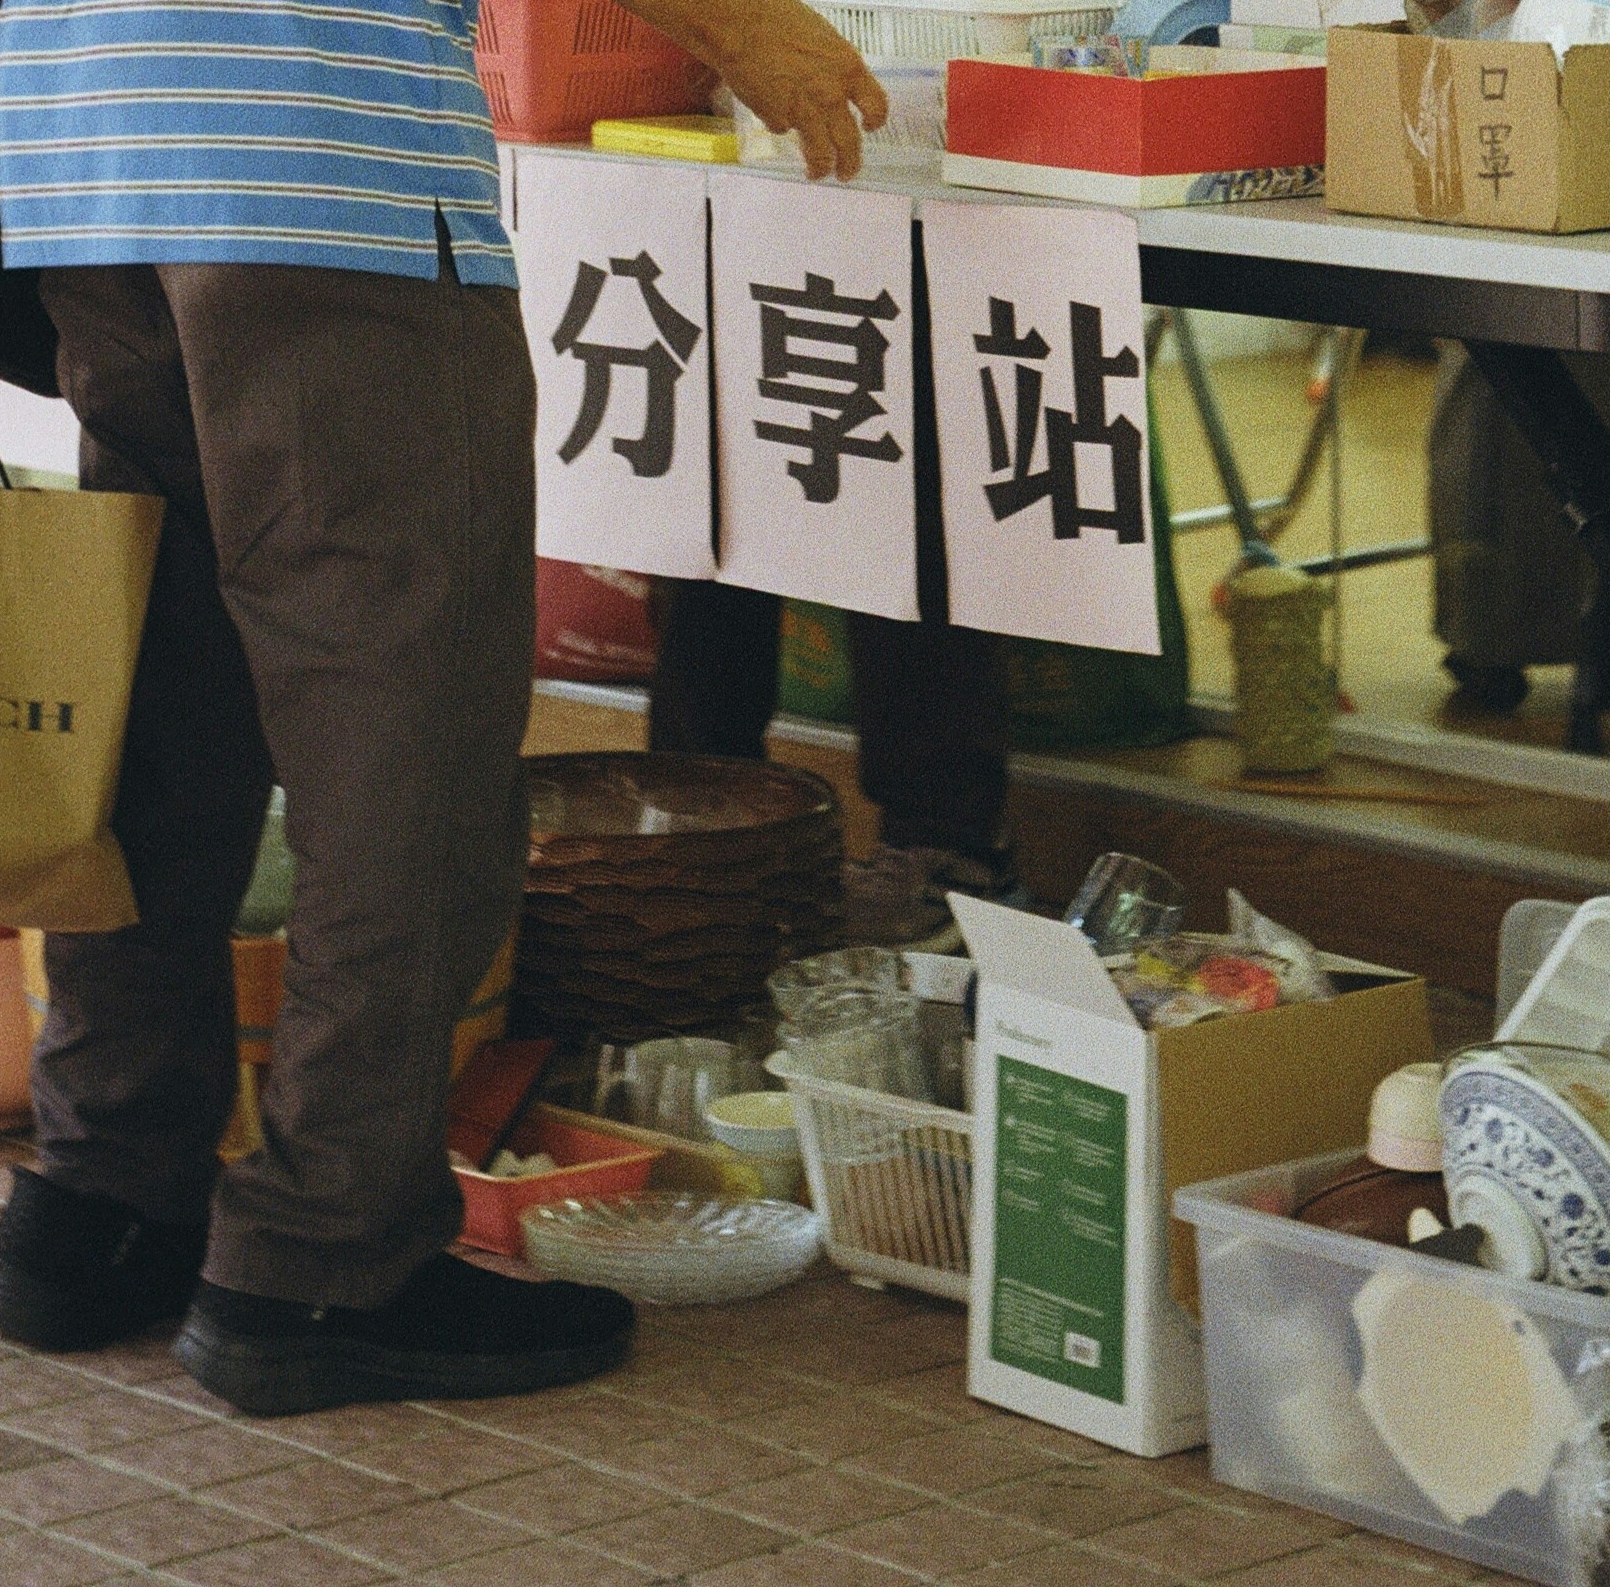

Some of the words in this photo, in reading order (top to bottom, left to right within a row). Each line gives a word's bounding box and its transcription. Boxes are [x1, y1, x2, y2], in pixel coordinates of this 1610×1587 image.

[1476, 66, 1515, 202] 口罩
[551, 250, 1145, 543] 分享站
